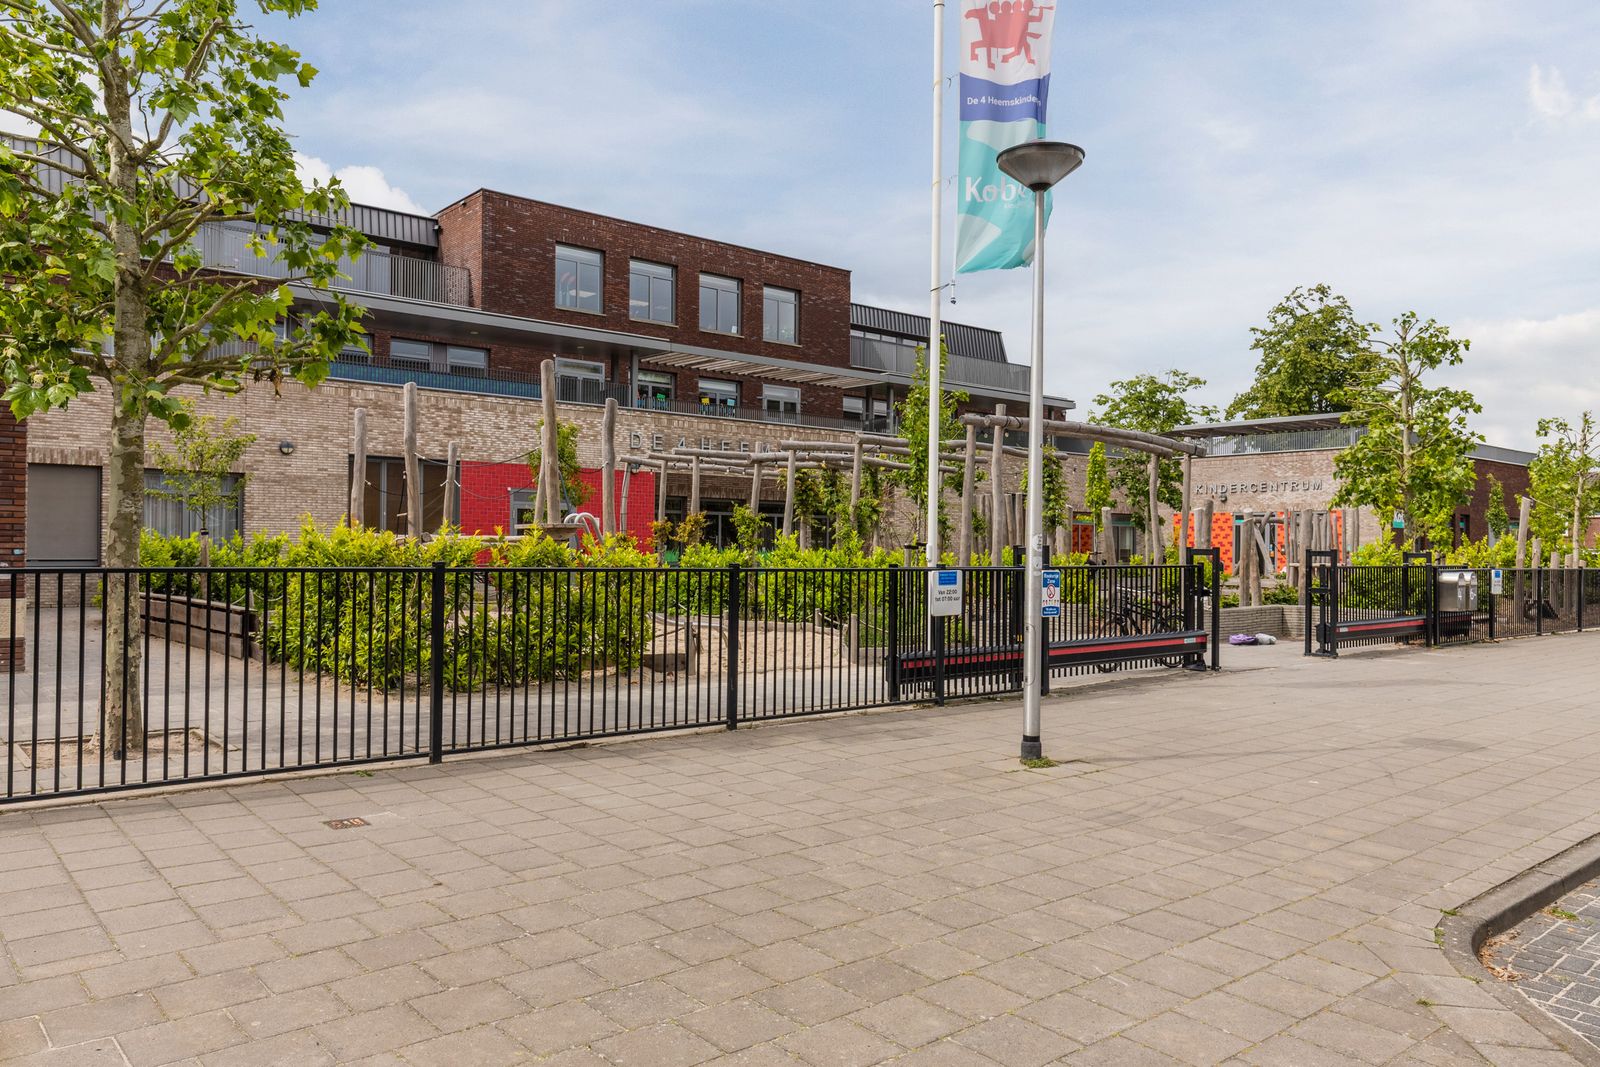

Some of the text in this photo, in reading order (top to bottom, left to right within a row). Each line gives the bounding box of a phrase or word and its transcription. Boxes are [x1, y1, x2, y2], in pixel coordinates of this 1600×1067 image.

[967, 97, 979, 105] De
[980, 95, 987, 104] 4
[965, 175, 1026, 203] Kob
[630, 431, 687, 451] DE 4
[1196, 480, 1323, 495] KINDERCENTRUM
